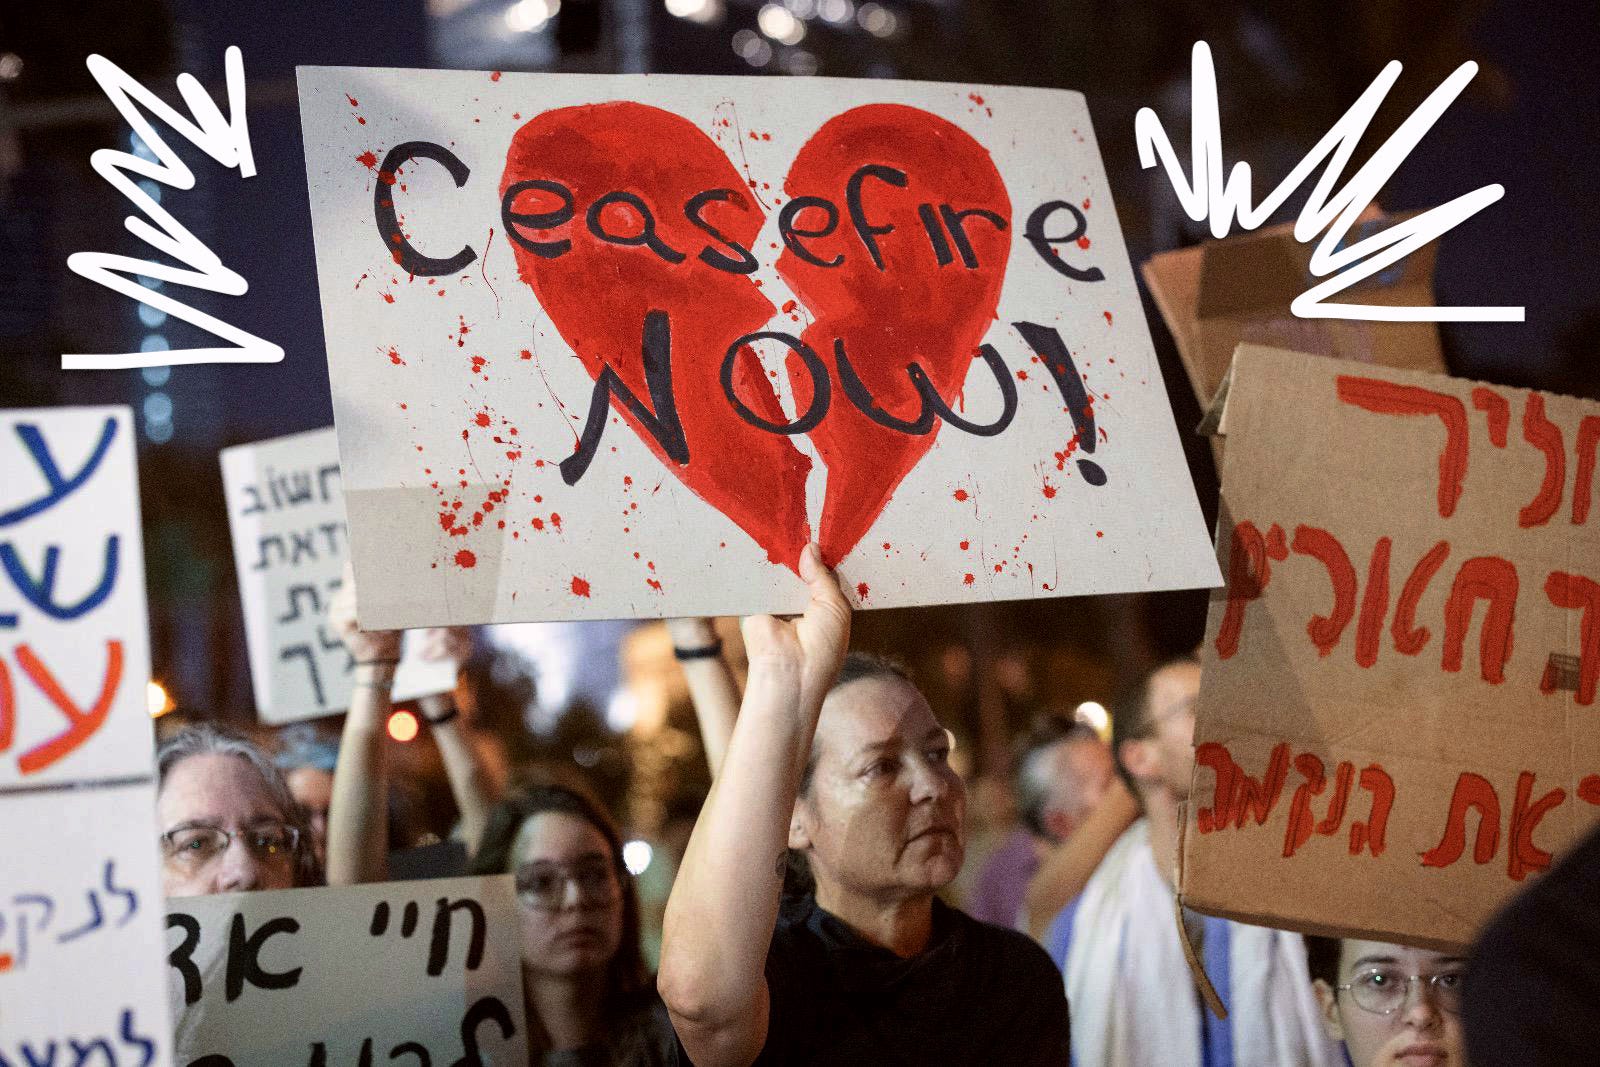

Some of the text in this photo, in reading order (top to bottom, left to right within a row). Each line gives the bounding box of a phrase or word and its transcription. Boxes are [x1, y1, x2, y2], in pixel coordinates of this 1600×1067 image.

[374, 141, 1106, 282] Ceasefire
[0, 860, 138, 968] לנק
[368, 897, 486, 977] חיי
